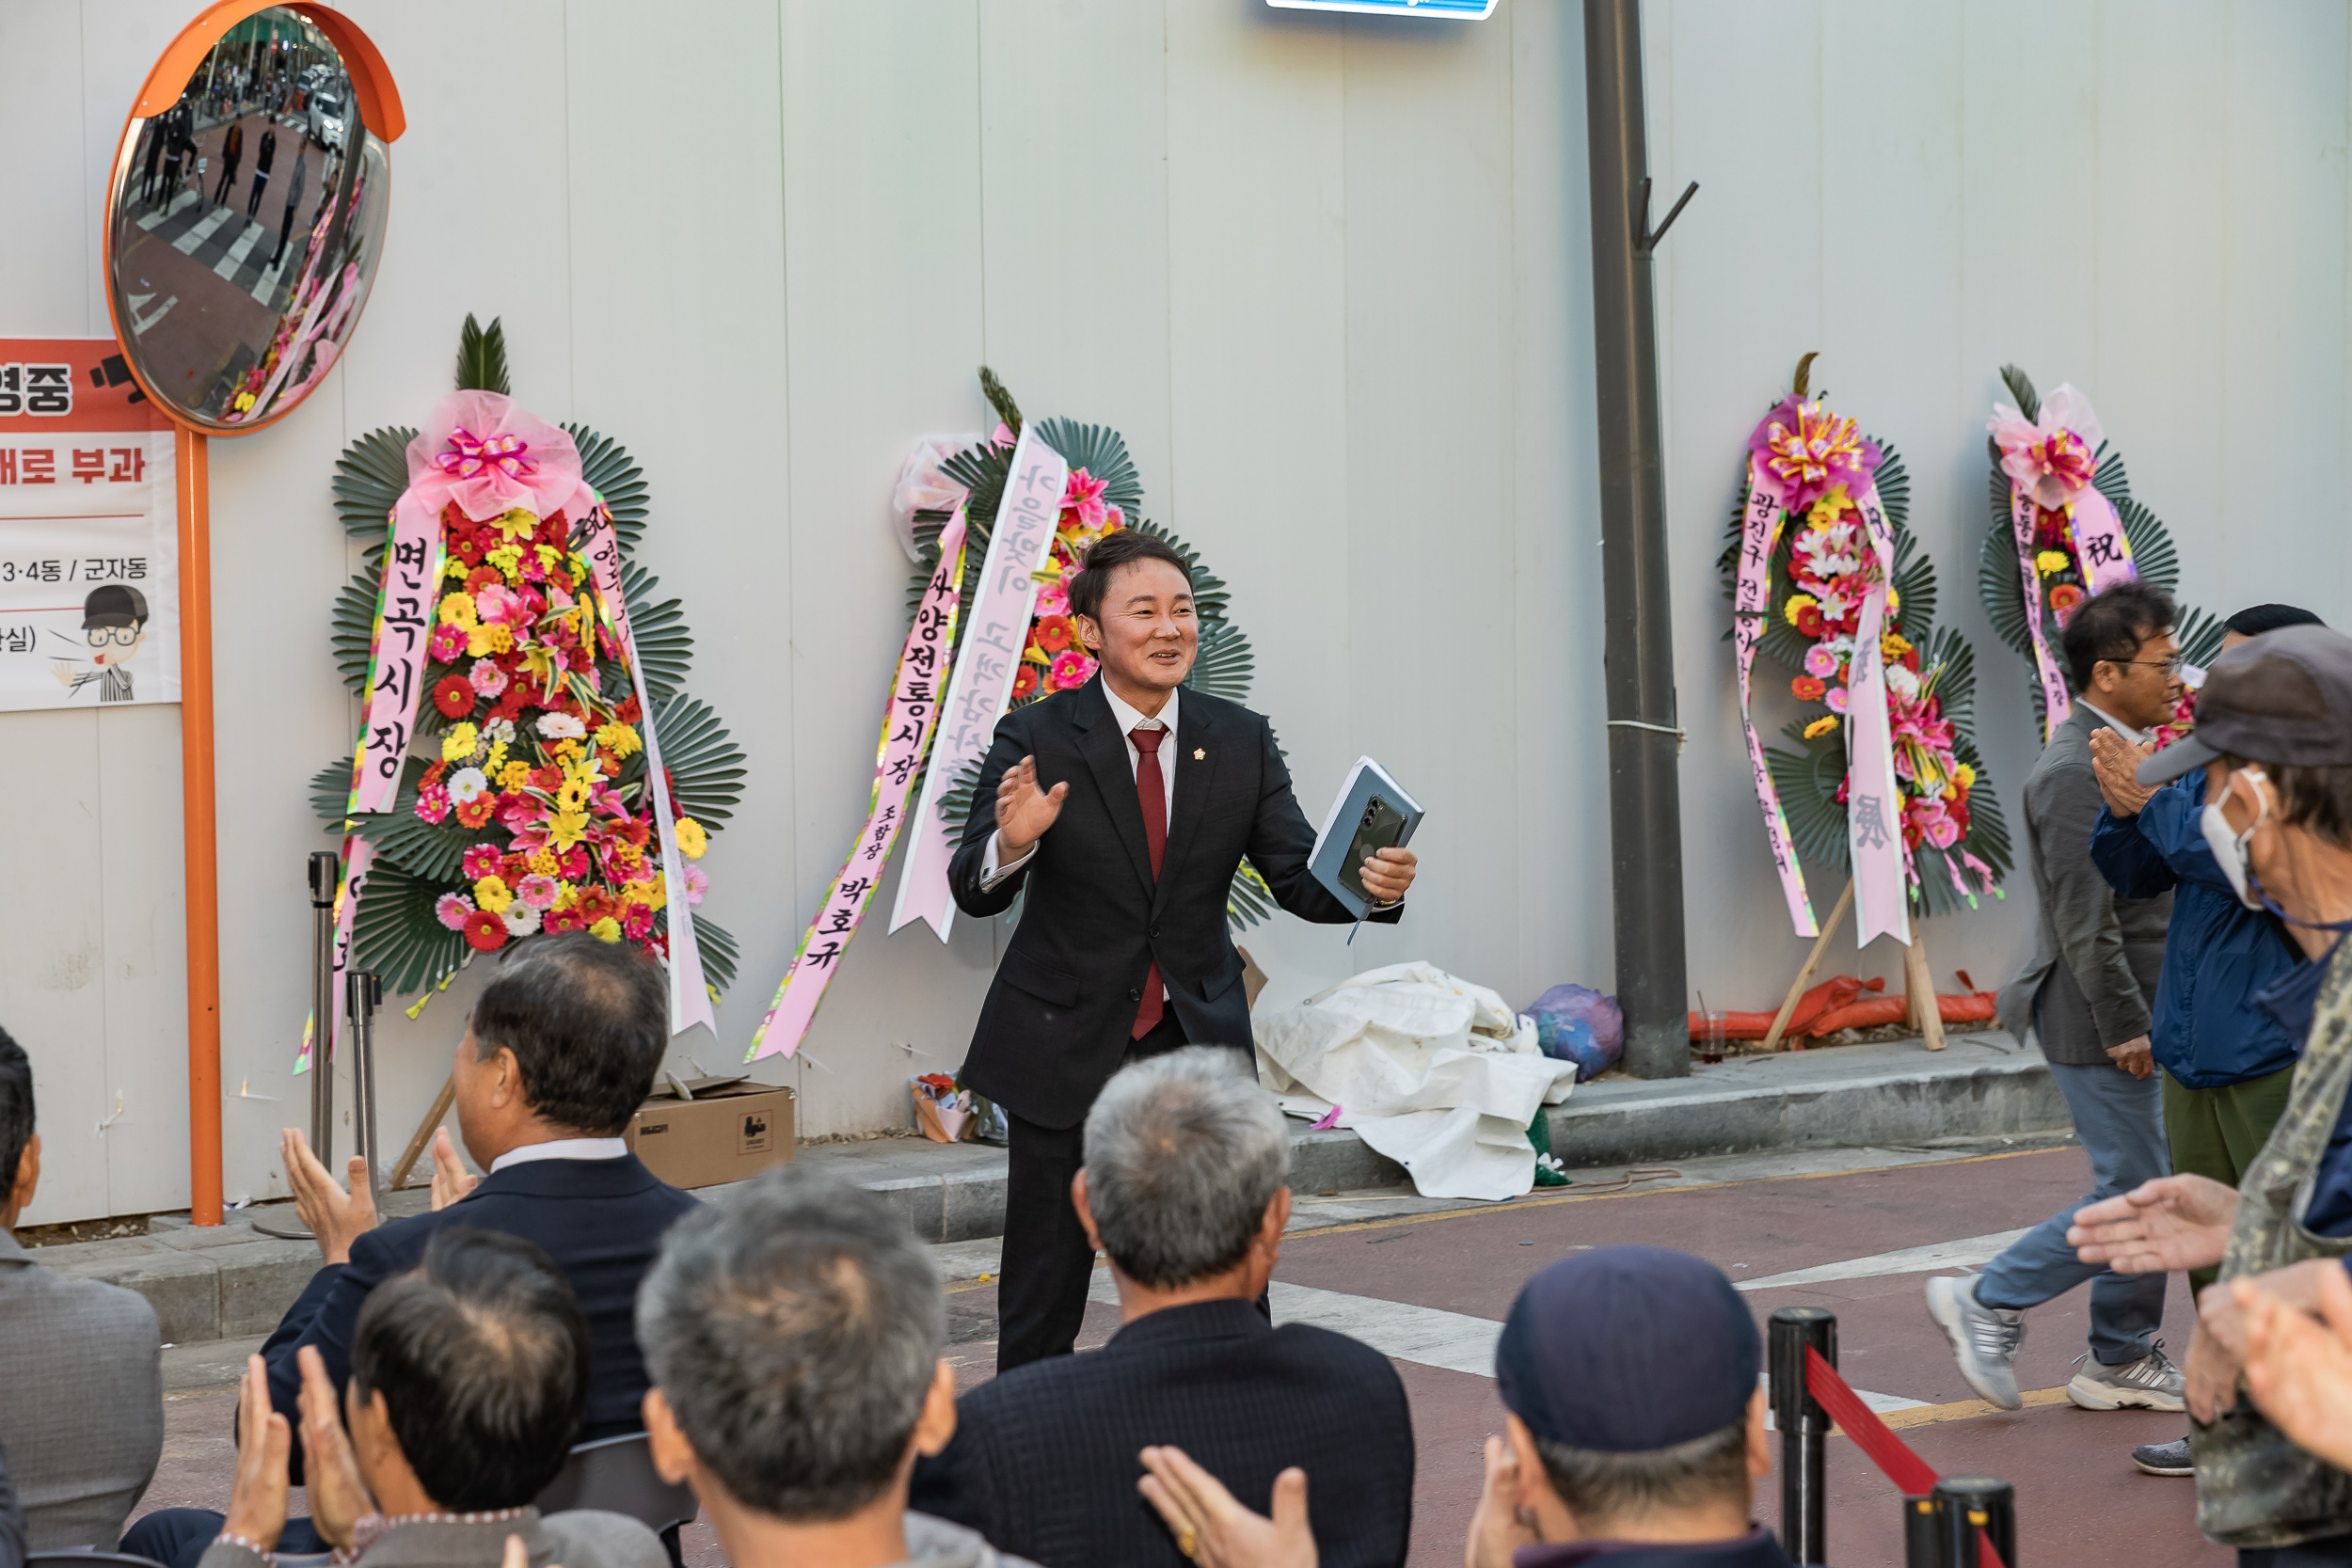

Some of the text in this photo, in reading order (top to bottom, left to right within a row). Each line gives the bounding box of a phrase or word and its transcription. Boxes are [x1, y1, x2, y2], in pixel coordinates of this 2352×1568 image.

[72, 448, 146, 483] 부과
[1742, 492, 1780, 568] 광진구
[2086, 532, 2123, 567] 祝
[85, 557, 147, 580] 군자동
[0, 626, 36, 653] 실)
[366, 537, 426, 779] 면곡시장
[806, 878, 872, 970] 박호규
